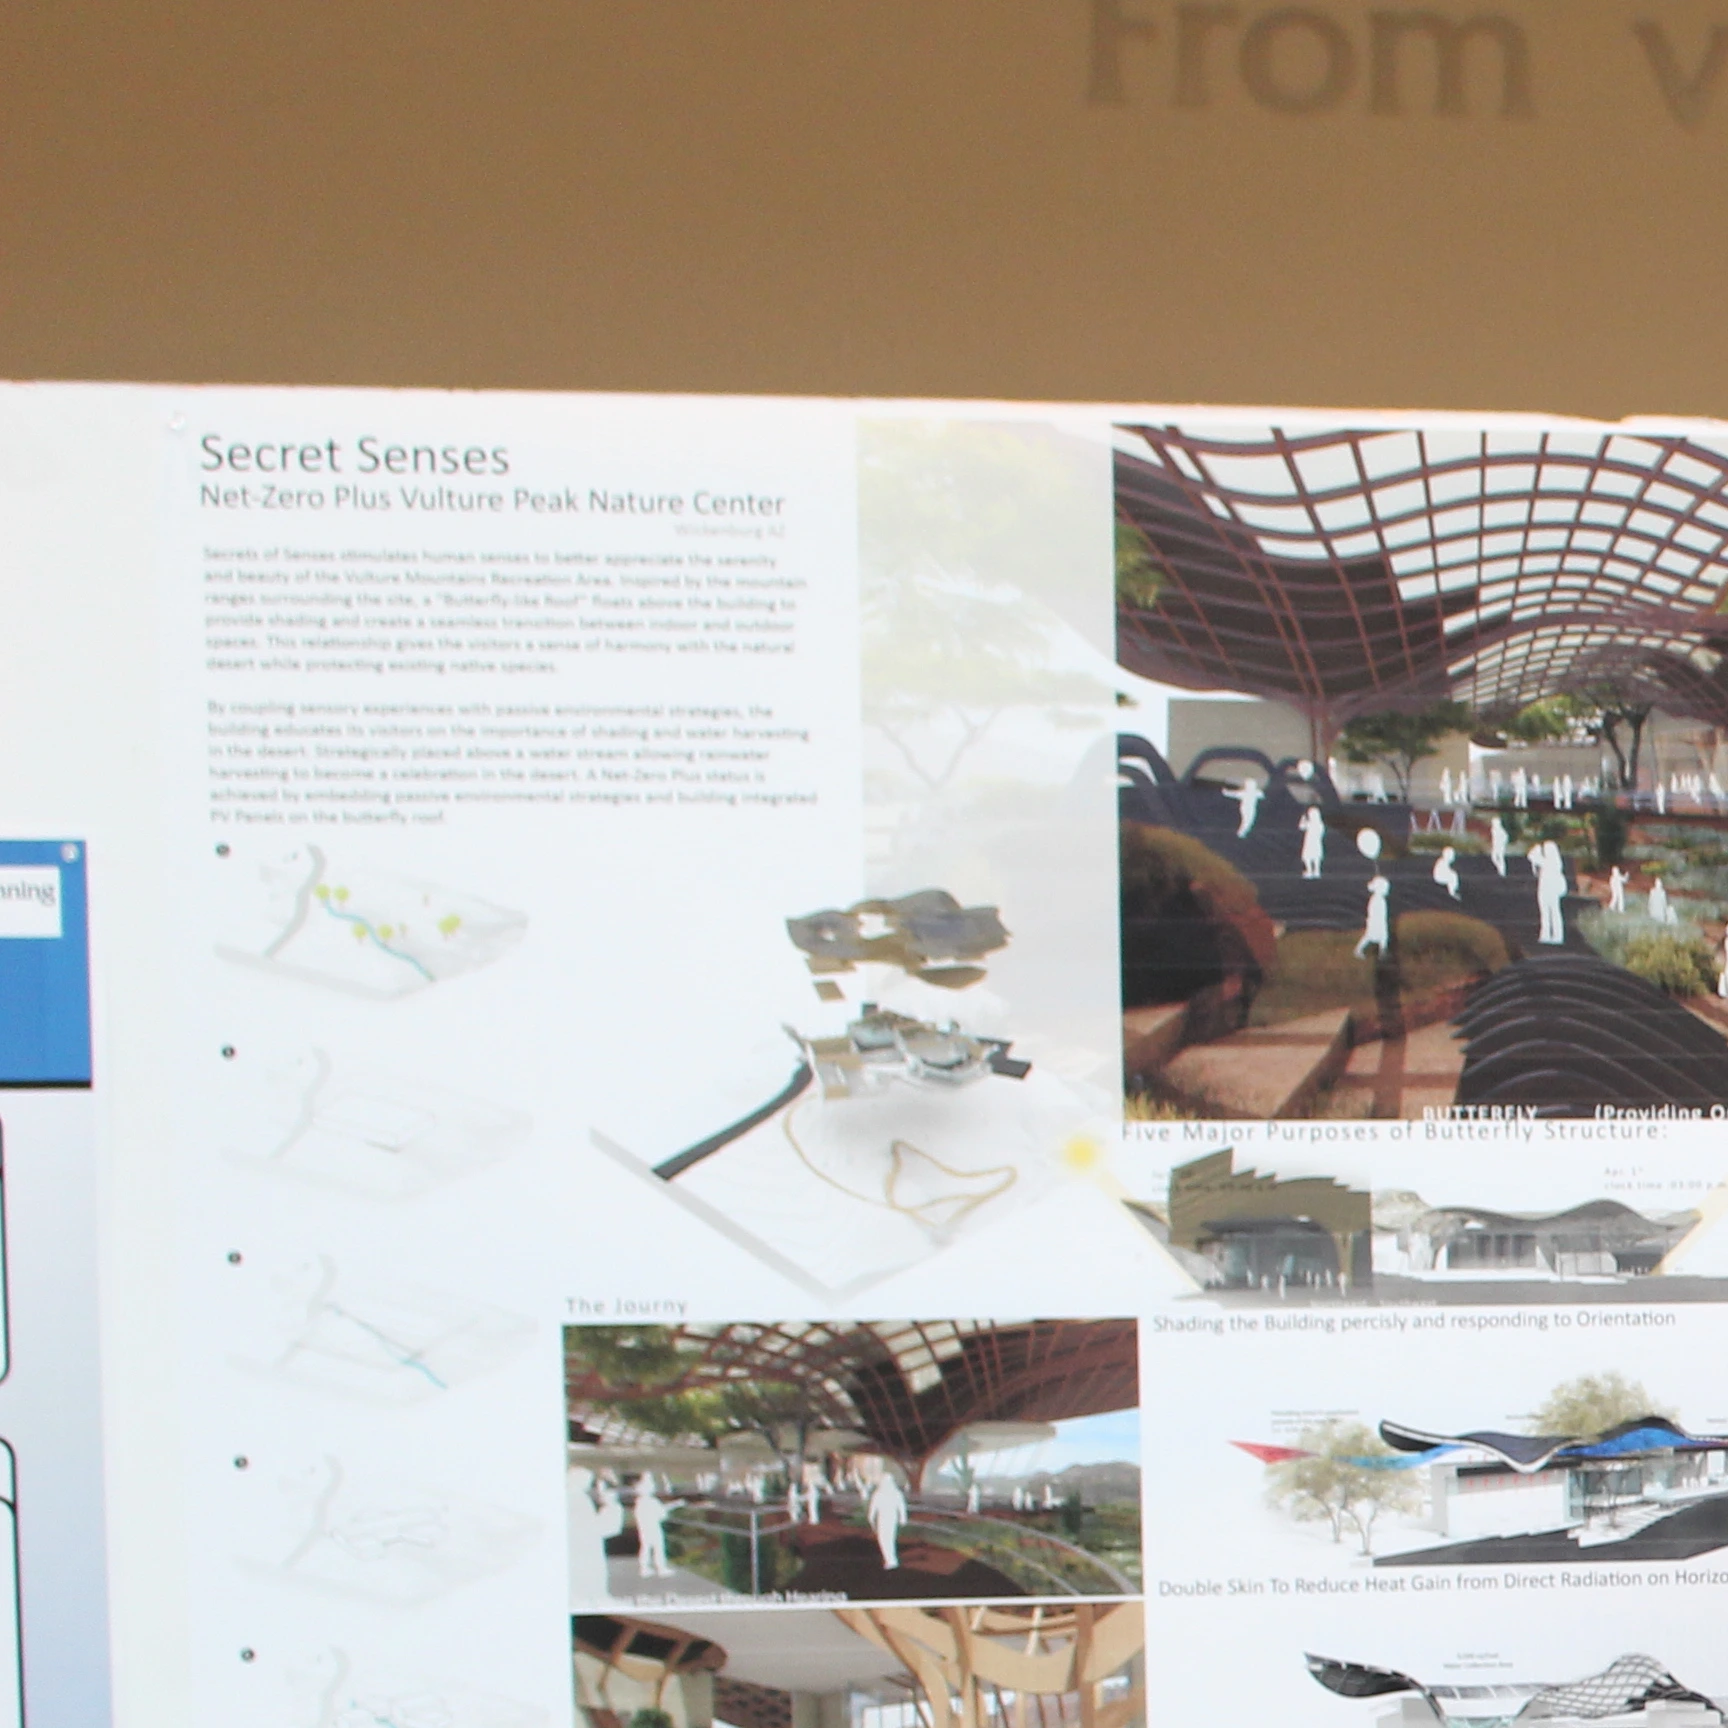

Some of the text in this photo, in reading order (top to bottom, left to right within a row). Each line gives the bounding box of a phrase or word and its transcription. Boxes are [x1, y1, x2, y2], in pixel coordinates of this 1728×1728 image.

[1084, 0, 1537, 121] From
[200, 434, 509, 475] Secret Senses
[198, 482, 783, 516] Net-Zero Plus Vulture Peak Nature Center
[1182, 1121, 1255, 1145] Major
[1266, 1121, 1379, 1144] Purposes
[1390, 1119, 1414, 1141] of
[1425, 1120, 1535, 1143] Butterfly
[1544, 1120, 1670, 1141] Structure:
[565, 1296, 604, 1315] The
[1152, 1310, 1676, 1335] Shading the Building percisly and responding to Orientation
[1158, 1580, 1222, 1596] Double
[1227, 1579, 1264, 1594] Skin
[1269, 1577, 1289, 1594] To
[1295, 1577, 1359, 1593] Reduce
[1365, 1576, 1405, 1591] Heat
[1411, 1574, 1451, 1591] Gain
[1456, 1572, 1498, 1589] from
[1504, 1572, 1555, 1588] Direct
[1561, 1571, 1642, 1587] Radiation
[1647, 1573, 1669, 1585] on
